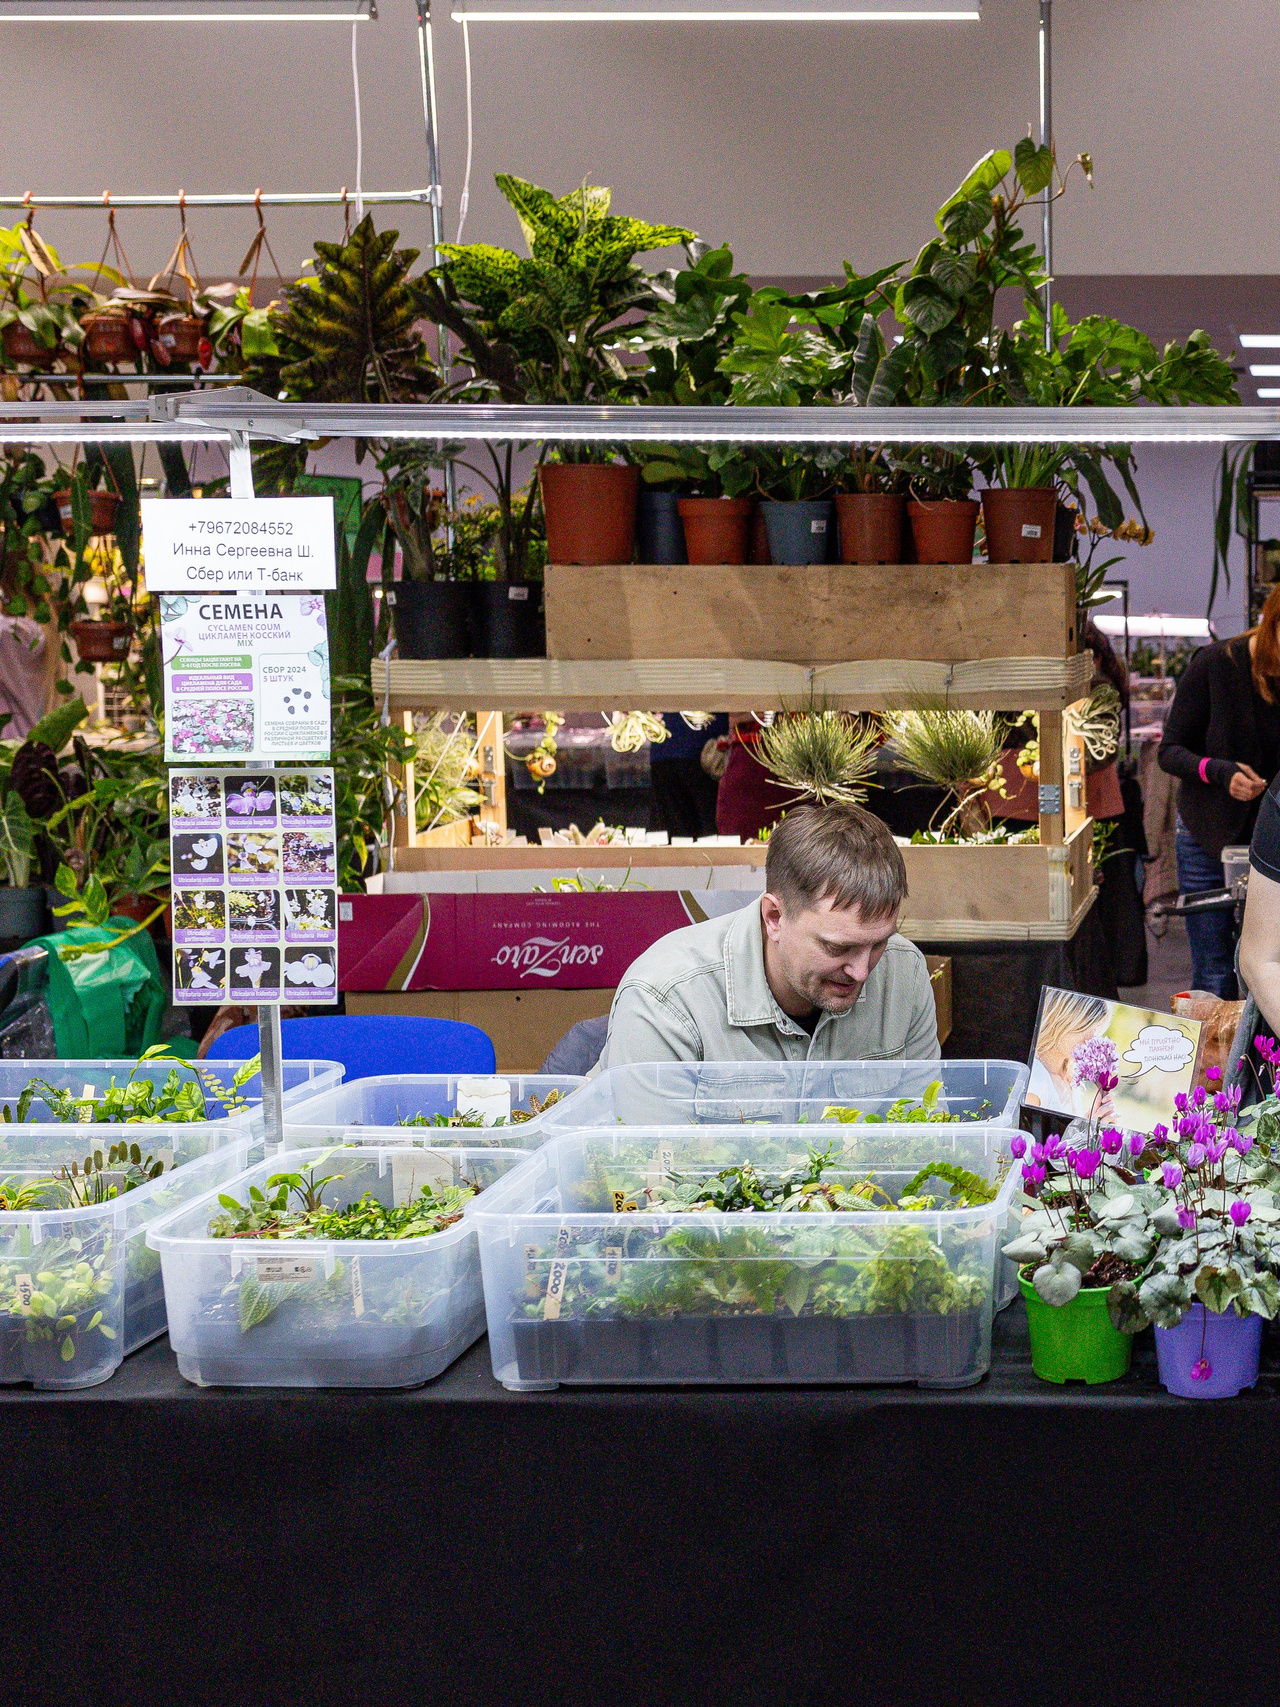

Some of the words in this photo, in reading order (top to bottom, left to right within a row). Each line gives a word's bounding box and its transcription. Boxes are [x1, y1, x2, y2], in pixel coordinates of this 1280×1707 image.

[188, 520, 294, 536] +79672084552
[173, 542, 211, 557] Инна
[216, 543, 292, 559] Сергеевна
[297, 544, 314, 558] Ш.
[186, 566, 224, 582] Сбер
[228, 570, 253, 581] или
[257, 567, 304, 582] Т-банк
[199, 603, 284, 620] СЕМЕНА
[207, 624, 254, 632] CYCLAMEN
[255, 623, 281, 631] COUM
[198, 632, 248, 641] ЦИКЛАМЕН
[250, 631, 291, 640] КОССКИЙ
[262, 666, 285, 674] СБОР
[550, 1262, 566, 1295] 2000
